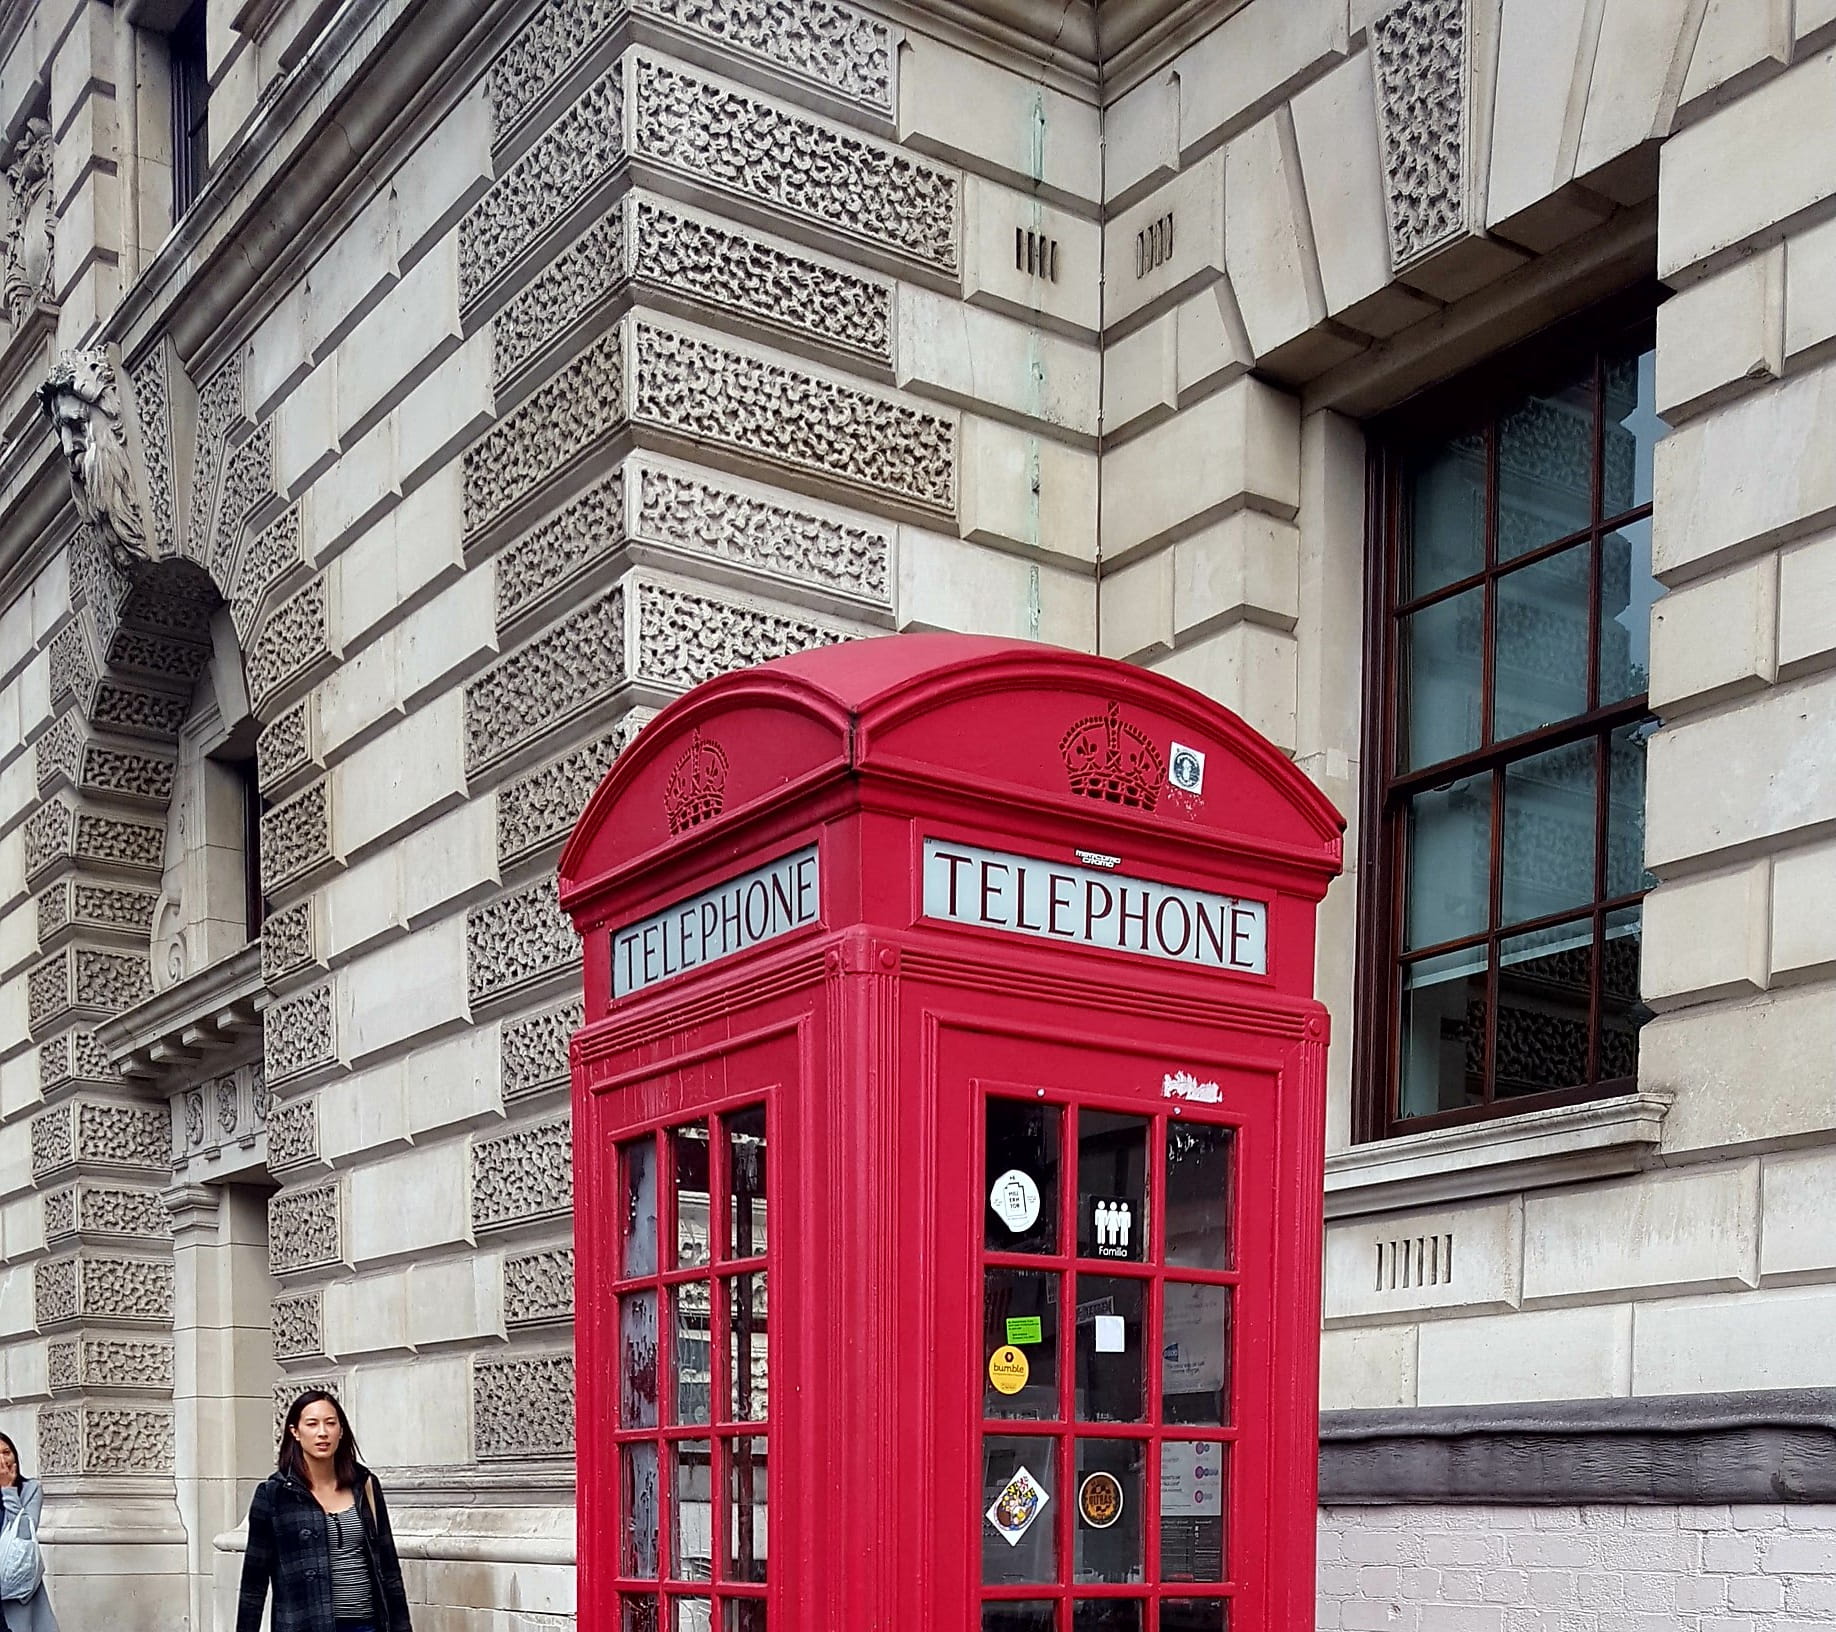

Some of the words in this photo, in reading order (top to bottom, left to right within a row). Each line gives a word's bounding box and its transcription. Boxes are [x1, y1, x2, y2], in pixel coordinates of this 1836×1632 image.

[620, 856, 817, 990] TELEPHONE
[933, 851, 1257, 968] TELEPHONE
[993, 1362, 1025, 1373] bumble
